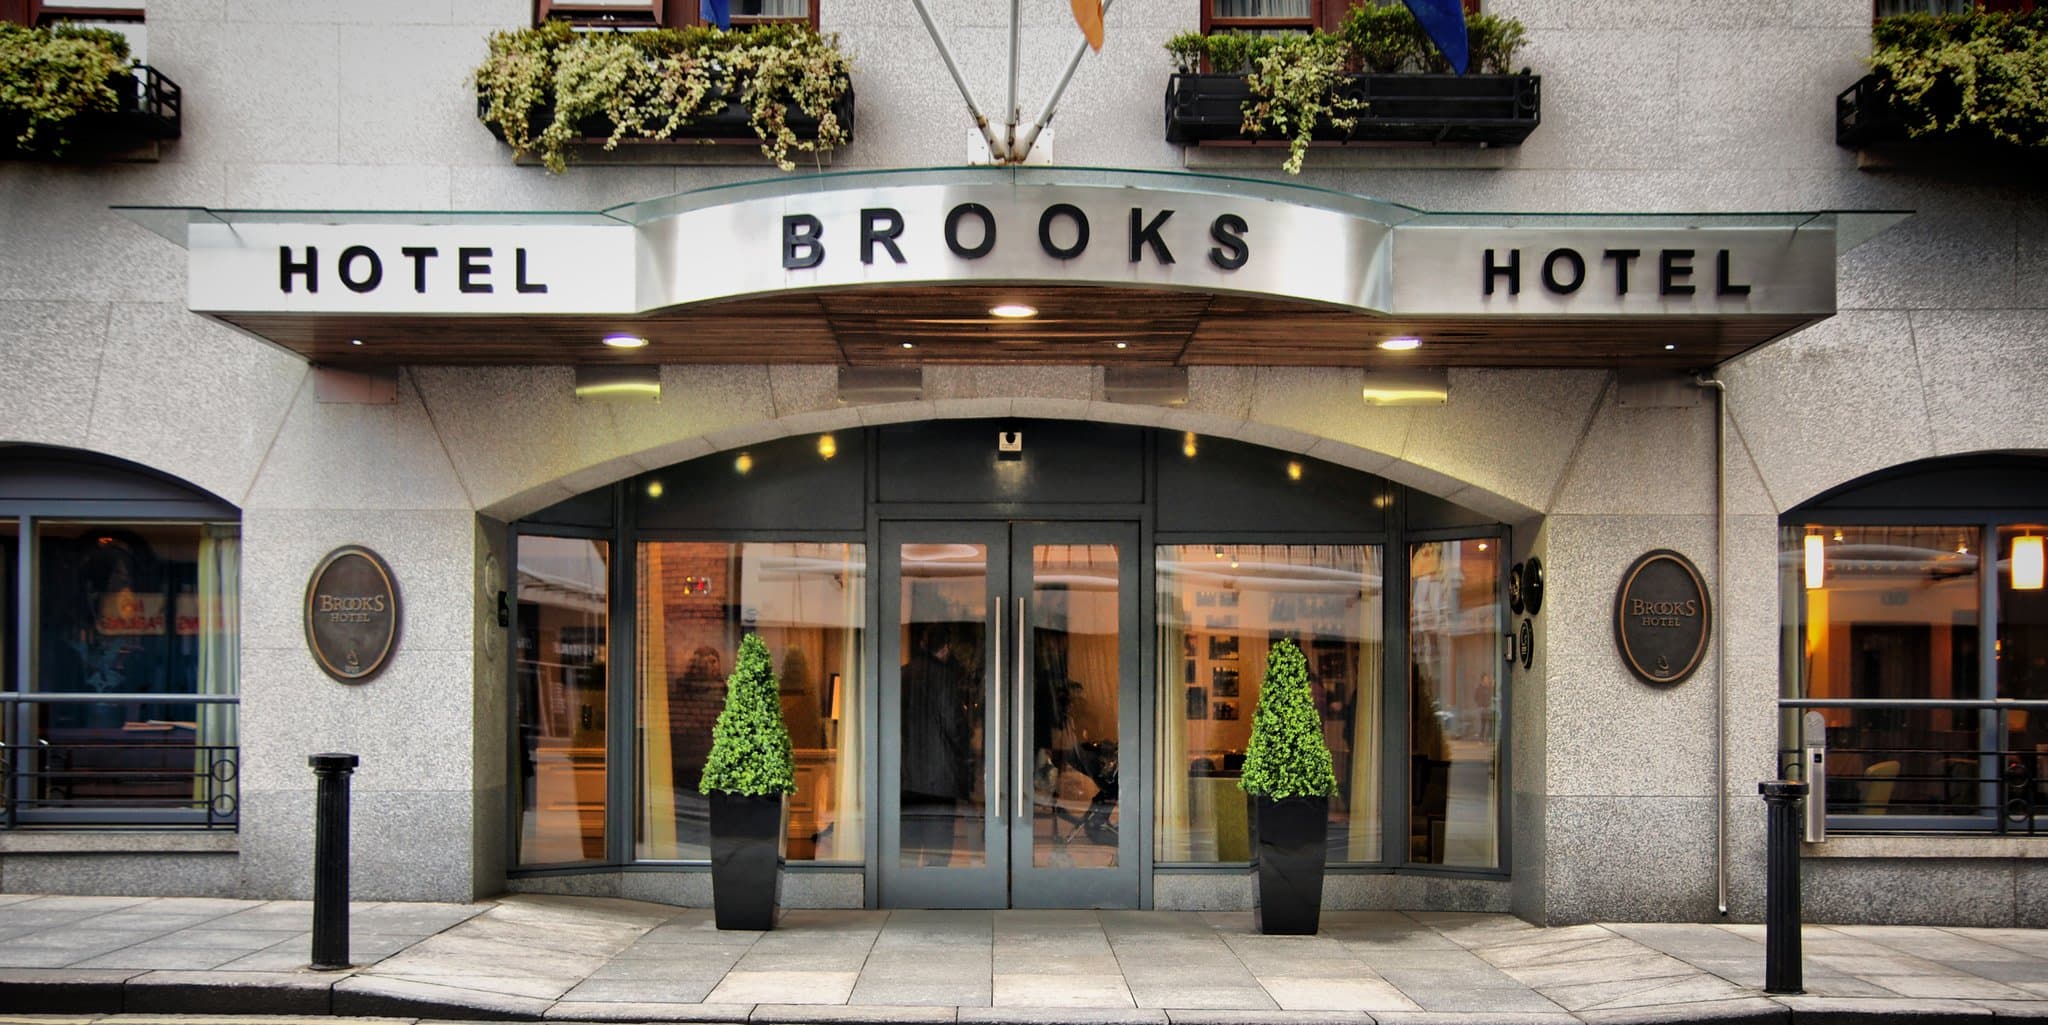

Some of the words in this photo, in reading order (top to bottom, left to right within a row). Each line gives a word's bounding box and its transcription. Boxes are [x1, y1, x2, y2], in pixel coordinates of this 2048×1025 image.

[782, 202, 1250, 271] BROOKS
[279, 245, 548, 294] HOTEL
[1482, 247, 1752, 297] HOTEL
[320, 594, 385, 611] BROOKS
[1631, 599, 1697, 616] BROOKS
[331, 612, 370, 622] HOTEL
[1641, 617, 1681, 627] HOTEL
